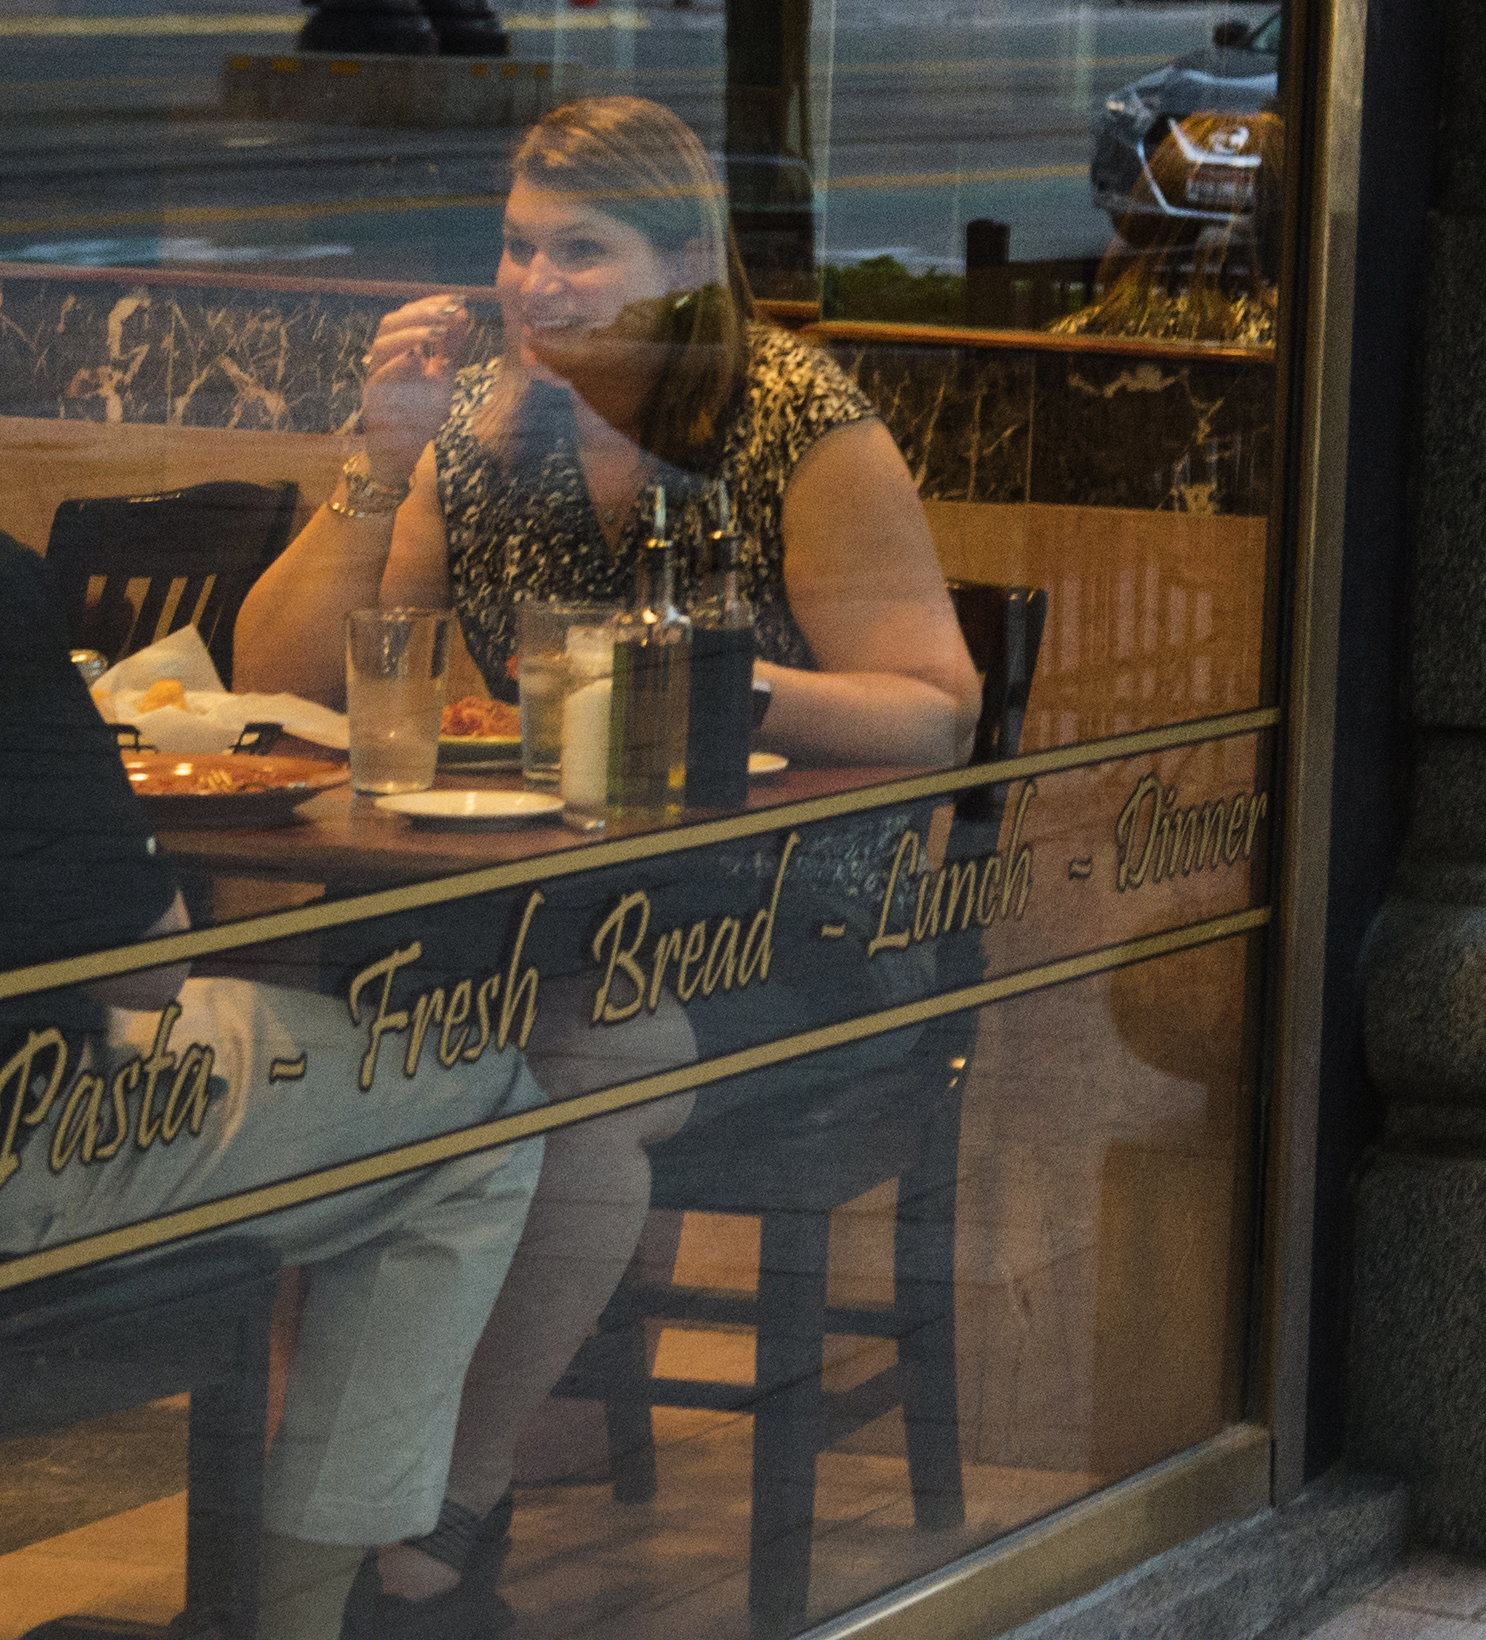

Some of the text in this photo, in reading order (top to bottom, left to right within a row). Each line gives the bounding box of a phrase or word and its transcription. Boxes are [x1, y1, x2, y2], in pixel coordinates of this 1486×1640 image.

[0, 1001, 215, 1189] Pasta
[349, 891, 545, 1091] Fresh
[590, 829, 799, 1025] Bread
[866, 776, 1038, 958] Lunch
[1115, 771, 1268, 893] Dinner
